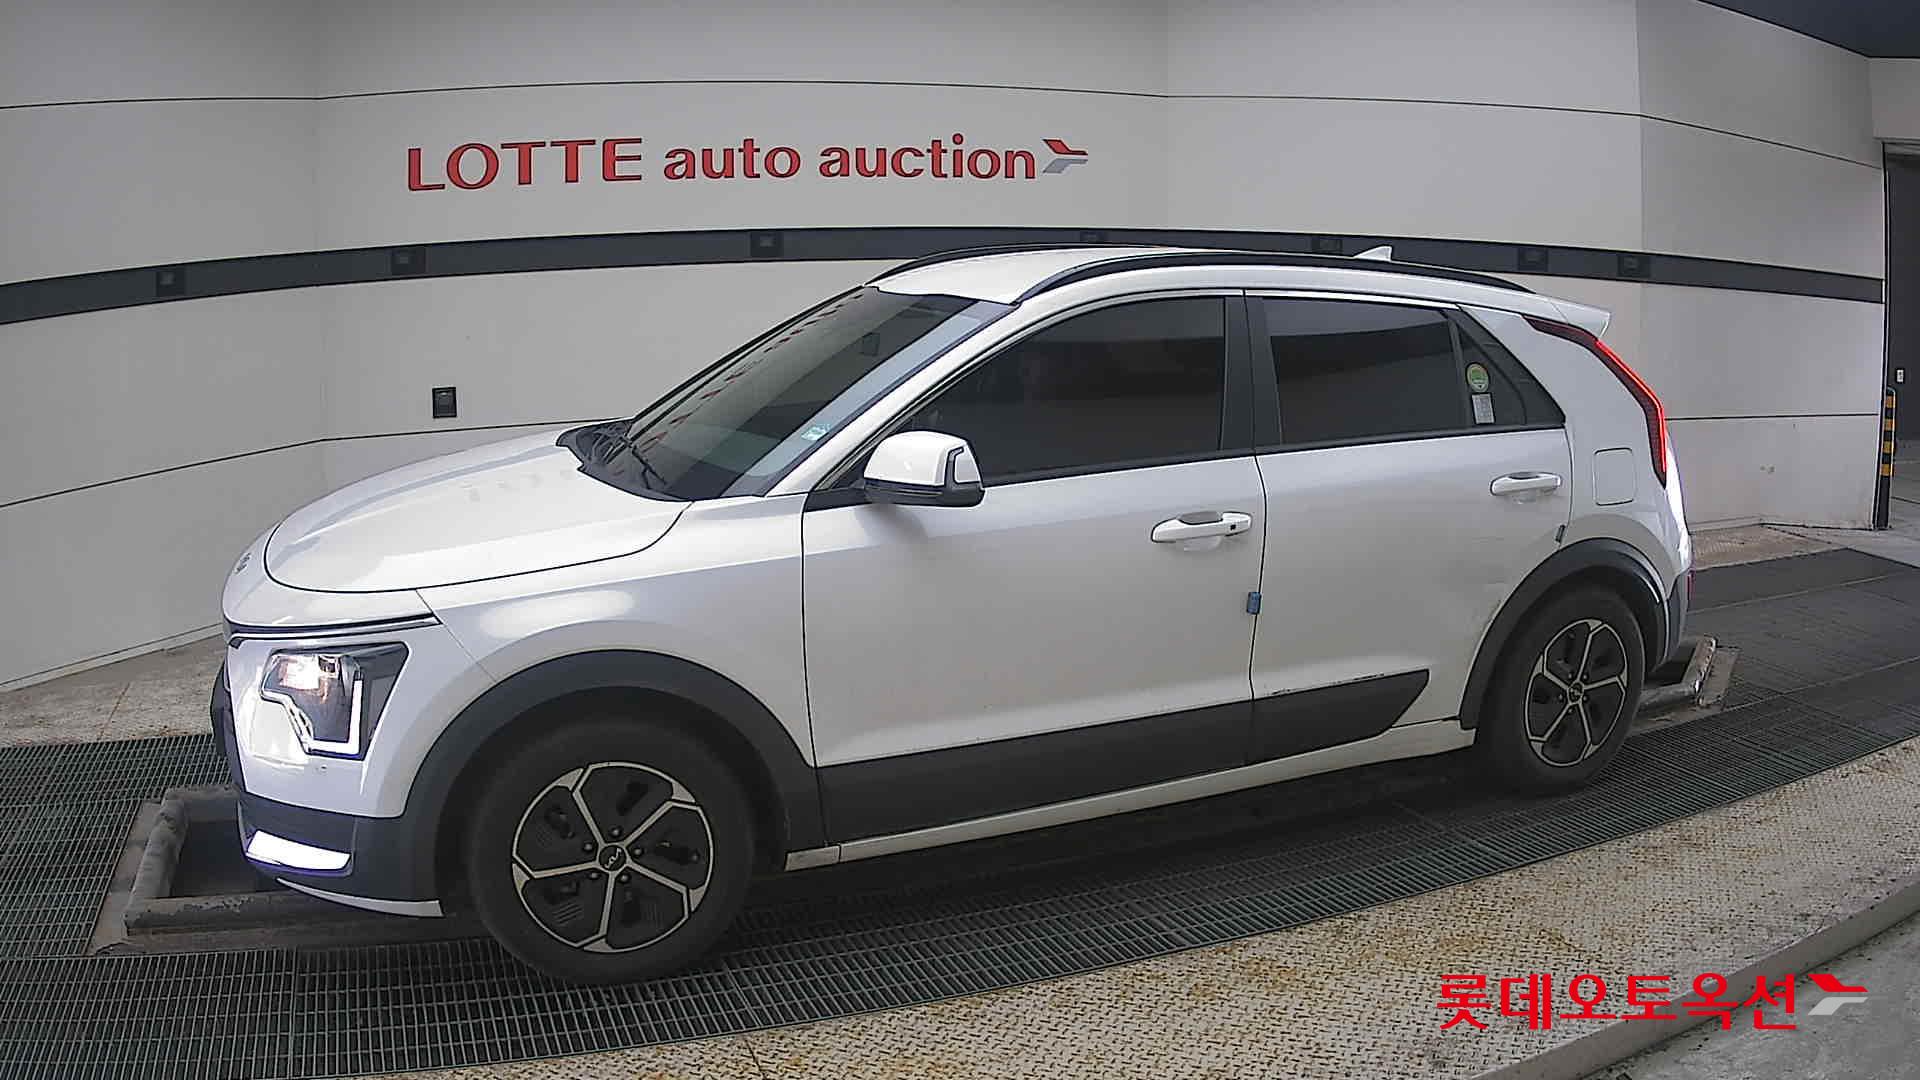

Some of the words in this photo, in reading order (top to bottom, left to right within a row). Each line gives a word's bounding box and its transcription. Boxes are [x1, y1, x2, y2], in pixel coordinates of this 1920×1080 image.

[407, 137, 643, 192] LOTTE
[663, 137, 801, 181] auto
[818, 133, 1037, 180] auction
